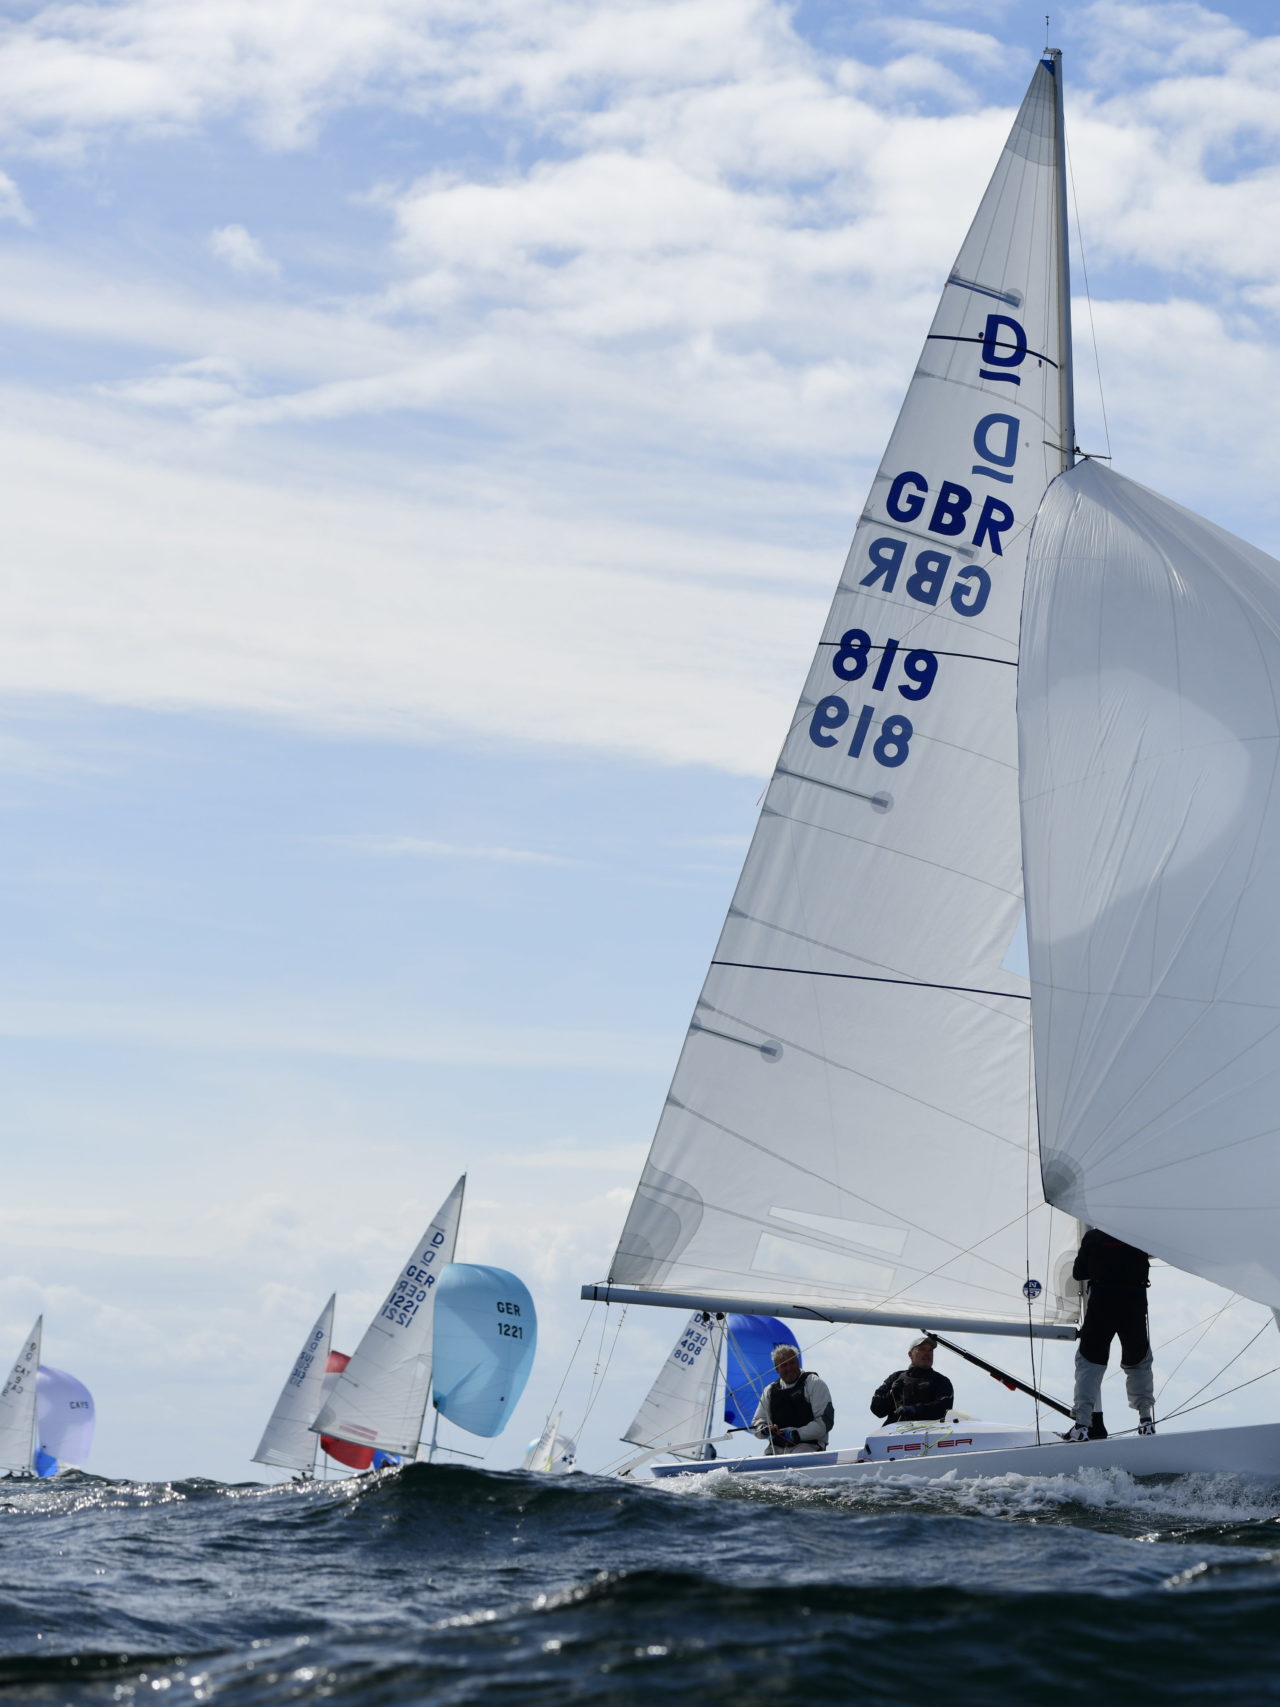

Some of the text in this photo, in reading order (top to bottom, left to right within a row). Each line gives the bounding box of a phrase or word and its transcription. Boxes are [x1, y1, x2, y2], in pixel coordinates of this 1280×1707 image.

[979, 314, 1027, 387] D
[886, 471, 1014, 557] GBR
[832, 629, 938, 701] 819
[406, 1265, 435, 1288] GER
[389, 1292, 419, 1315] 1221
[496, 1301, 521, 1317] GER
[497, 1322, 523, 1340] 1221
[681, 1339, 702, 1356] 408
